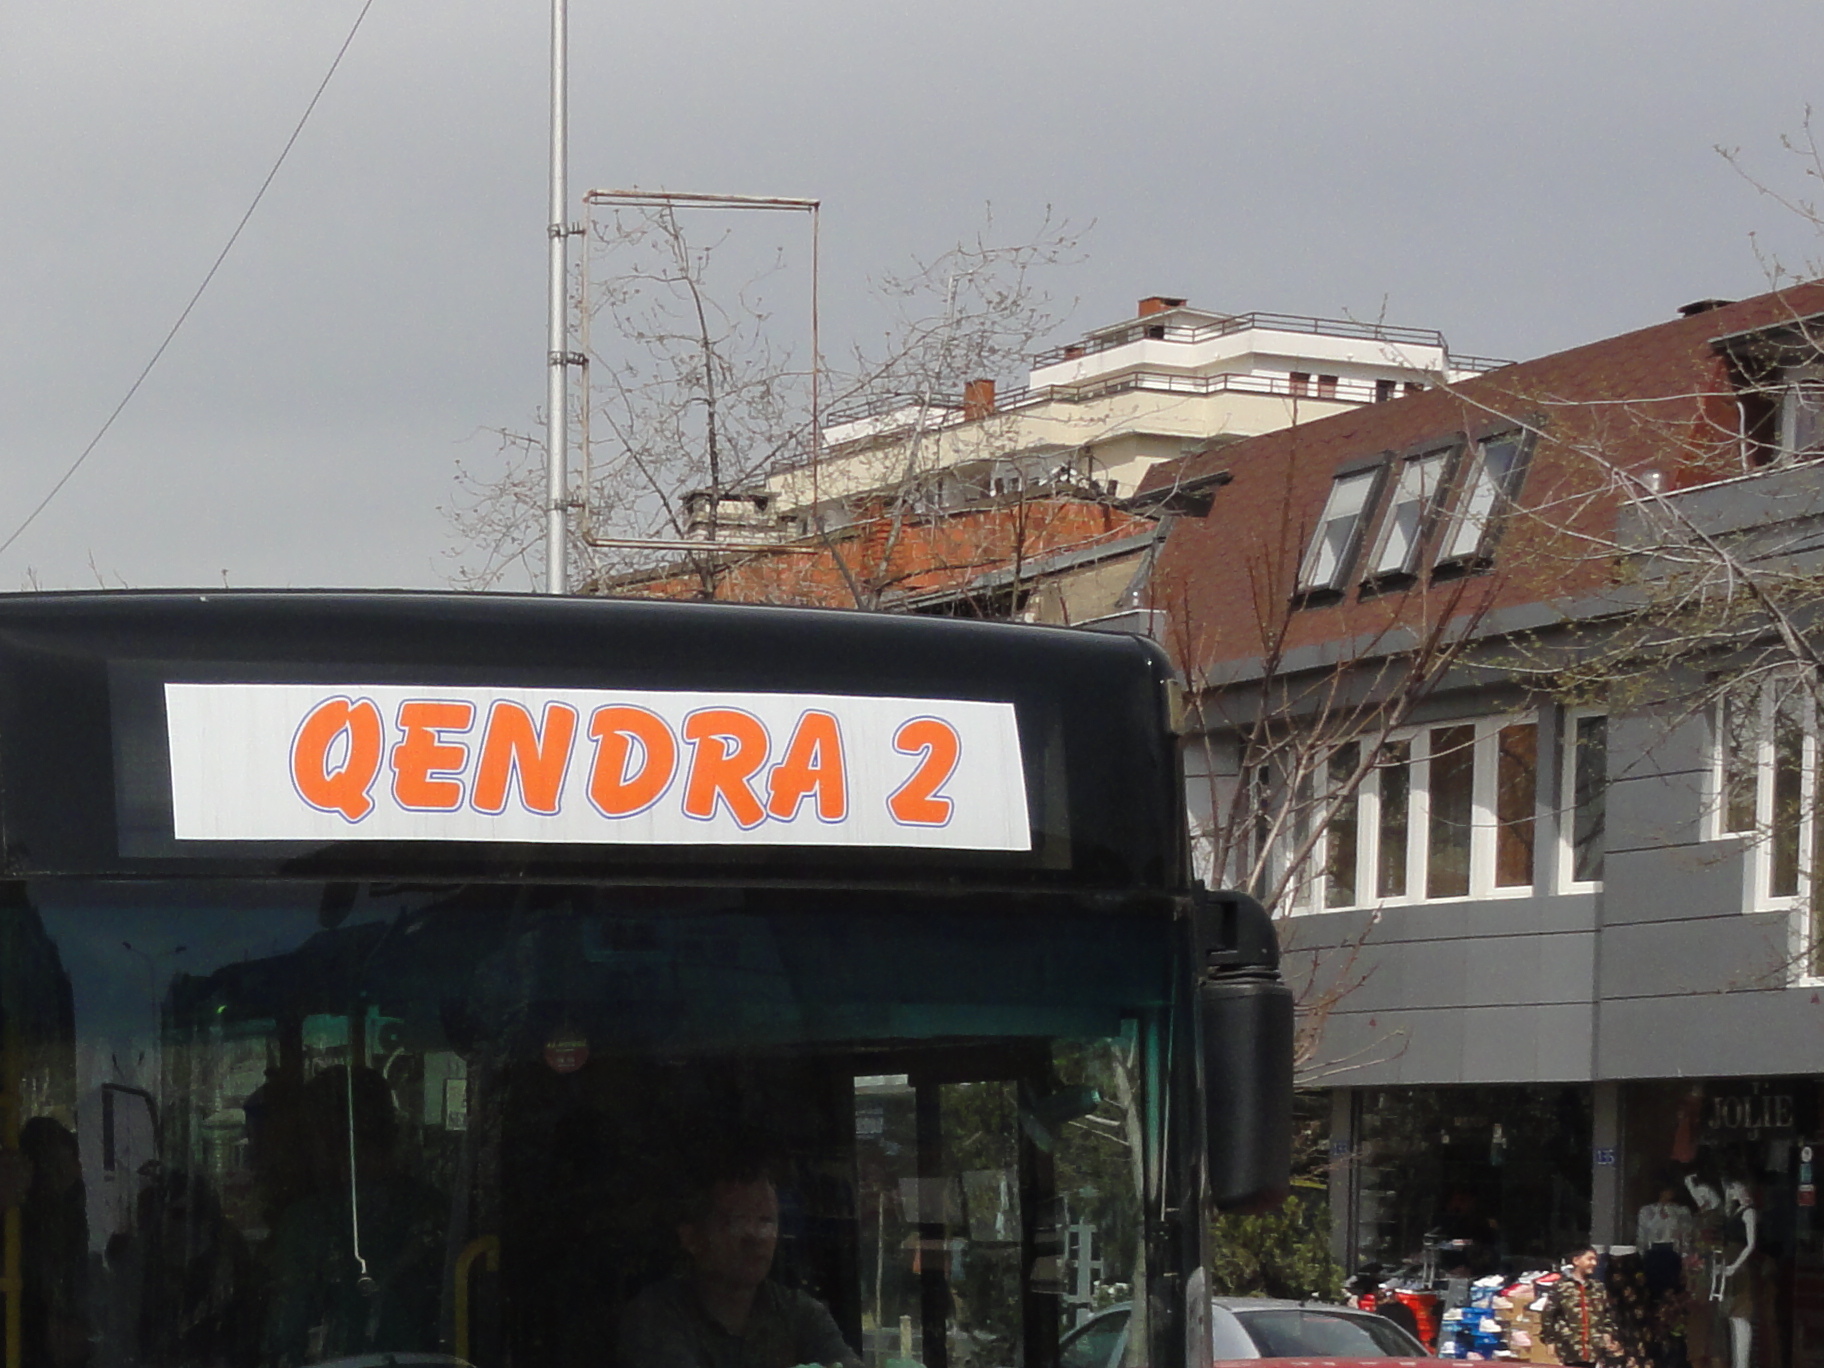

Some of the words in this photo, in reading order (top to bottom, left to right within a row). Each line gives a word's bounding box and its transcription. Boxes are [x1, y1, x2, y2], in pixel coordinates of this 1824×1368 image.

[290, 695, 849, 831] QENDRA
[887, 714, 962, 829] 2
[1708, 1096, 1794, 1129] JOLIE
